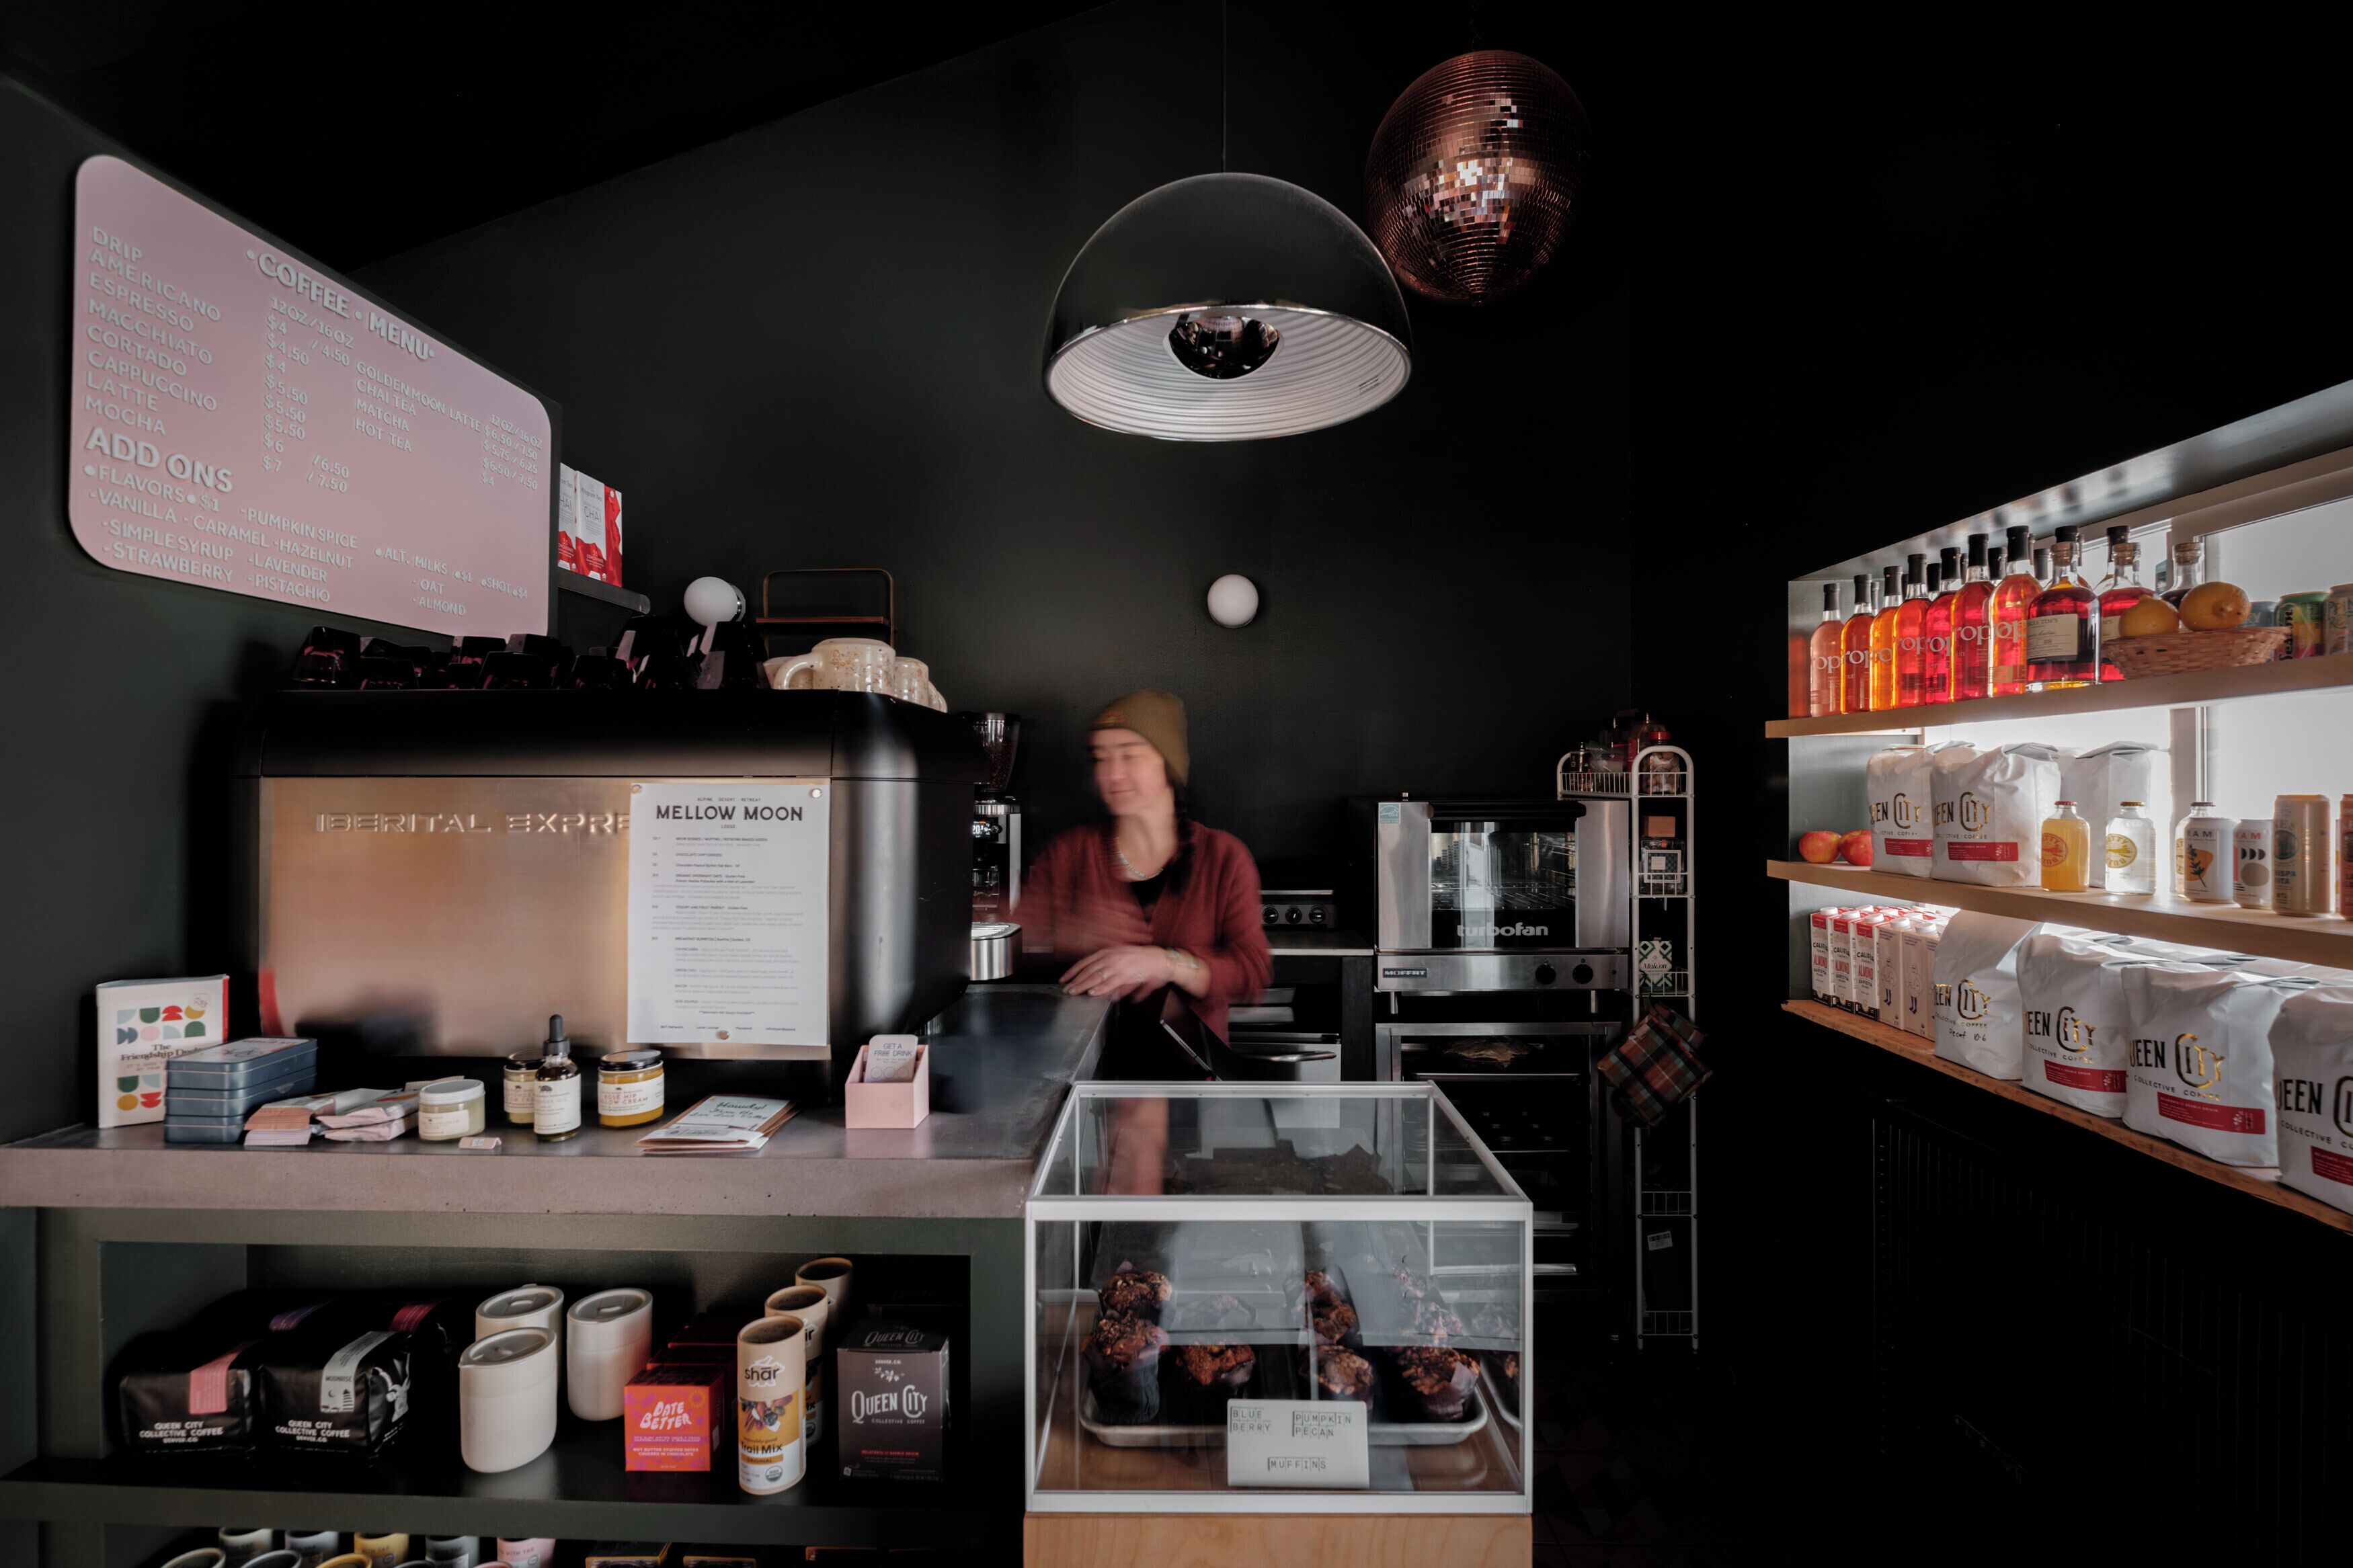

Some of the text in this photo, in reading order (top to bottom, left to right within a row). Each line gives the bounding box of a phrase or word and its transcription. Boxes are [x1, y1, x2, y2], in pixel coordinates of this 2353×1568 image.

[93, 226, 143, 263] DRIP
[89, 248, 221, 322] AMERICANO
[89, 272, 194, 332] ESPRESSO
[258, 253, 429, 361] COFFEE MENU
[88, 298, 212, 364] MACCHIATO
[87, 325, 187, 376] CORTADO
[87, 350, 218, 411] CAPPUCCINO
[87, 371, 159, 412] LATTE
[356, 361, 481, 434] GOLDEN MOON LATTE
[356, 378, 417, 417] CHAI TEA
[85, 395, 166, 435] MOCHA
[356, 398, 410, 432] MATCHA
[355, 417, 413, 453] HOT TEA
[85, 427, 233, 493] ADD ONS
[98, 464, 186, 503] FLAVORS
[176, 534, 235, 562] SYRUP
[318, 528, 358, 549] SPICE
[414, 555, 448, 576] MILKS
[485, 577, 512, 594] SHOT
[316, 813, 491, 833] IBERITAL
[656, 805, 803, 821] MELLOW MOON
[1894, 792, 1921, 829] CITY
[1960, 791, 1991, 832] CITY
[1457, 921, 1548, 937] turbofan
[1813, 942, 1829, 951] CALIFIA
[1833, 947, 1850, 956] CALIFIA
[1857, 952, 1874, 962] CALIFIA
[1958, 979, 1991, 1020] CITY
[1949, 1028, 1966, 1039] Decaf
[2057, 1006, 2097, 1053] CITY
[120, 1049, 173, 1061] Friendship
[152, 1044, 171, 1052] The
[2176, 1033, 2225, 1089] CITY
[2134, 1074, 2221, 1102] COLLECTIVE COFFEE
[2280, 1119, 2331, 1144] COLLECTIVE
[863, 1330, 926, 1348] QUEEN CITY
[653, 1401, 684, 1417] DATE
[851, 1385, 928, 1424] QUEEN CITY
[1233, 1409, 1262, 1419] BLUE
[155, 1421, 204, 1430] QUEEN CITY
[275, 1425, 351, 1438] COLLECTIVE COFFEE
[288, 1419, 333, 1430] QUEEN CITY
[639, 1412, 692, 1430] BETTER
[1233, 1423, 1271, 1433] BERRY
[1295, 1414, 1351, 1424] PUMPKIN
[1295, 1427, 1334, 1437] PECAN
[138, 1427, 224, 1438] COLLECTIVE COFFEE
[761, 1444, 783, 1454] Mix
[1271, 1460, 1327, 1470] MUFFINS
